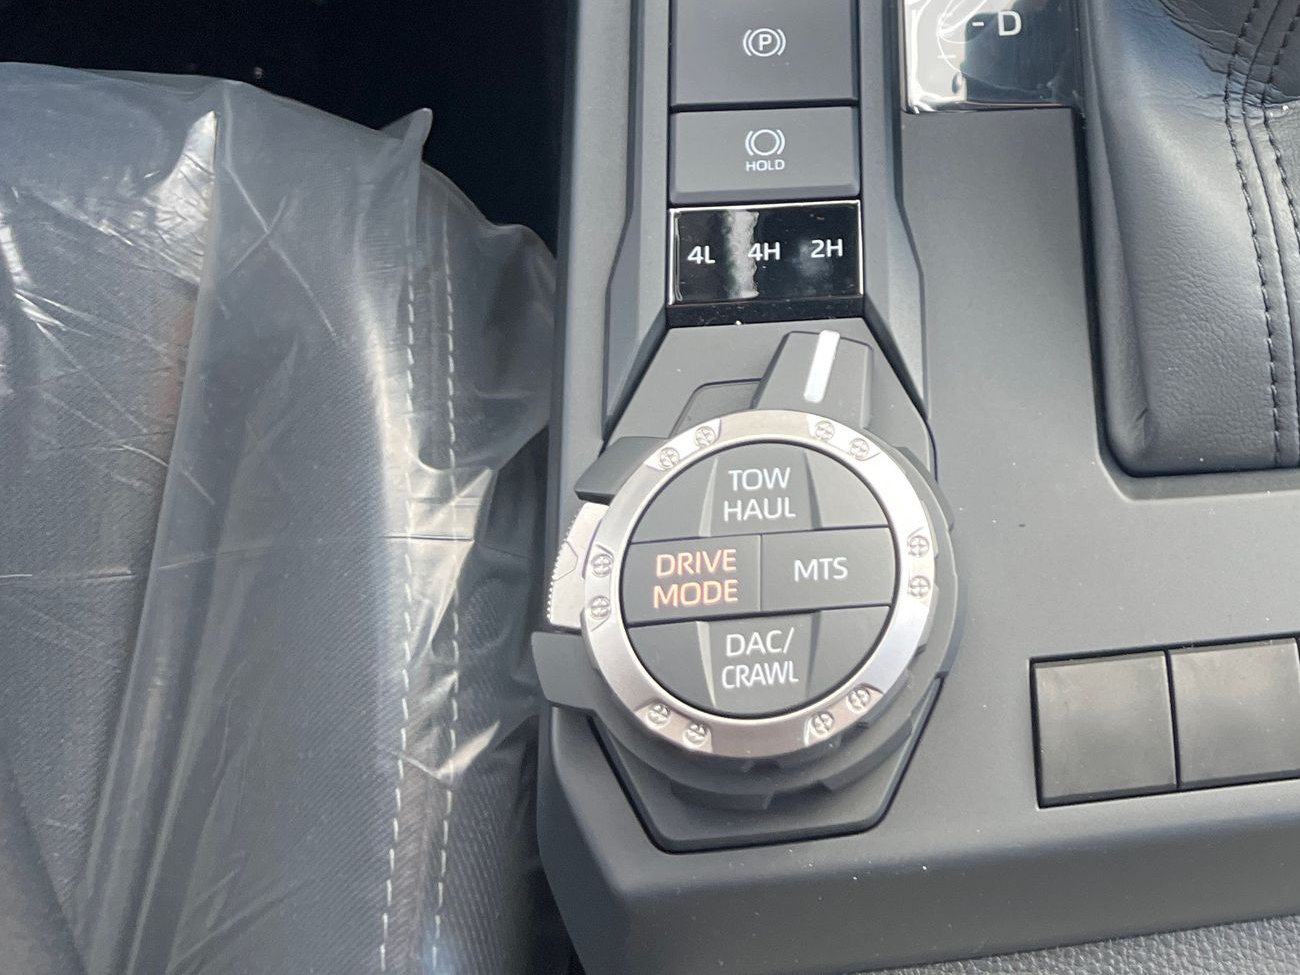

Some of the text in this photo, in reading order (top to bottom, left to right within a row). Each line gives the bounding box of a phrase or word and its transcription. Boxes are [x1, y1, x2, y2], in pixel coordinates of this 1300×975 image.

[997, 10, 1022, 36] D
[746, 159, 786, 172] HOLD
[687, 238, 844, 265] 4L 4H 2H
[728, 466, 791, 492] TOW
[722, 496, 796, 522] HAUL
[655, 548, 737, 578] DRIVE
[793, 557, 849, 583] MTS
[652, 579, 739, 609] MODE
[725, 627, 795, 658] DAC/
[721, 660, 799, 689] CRAWL
